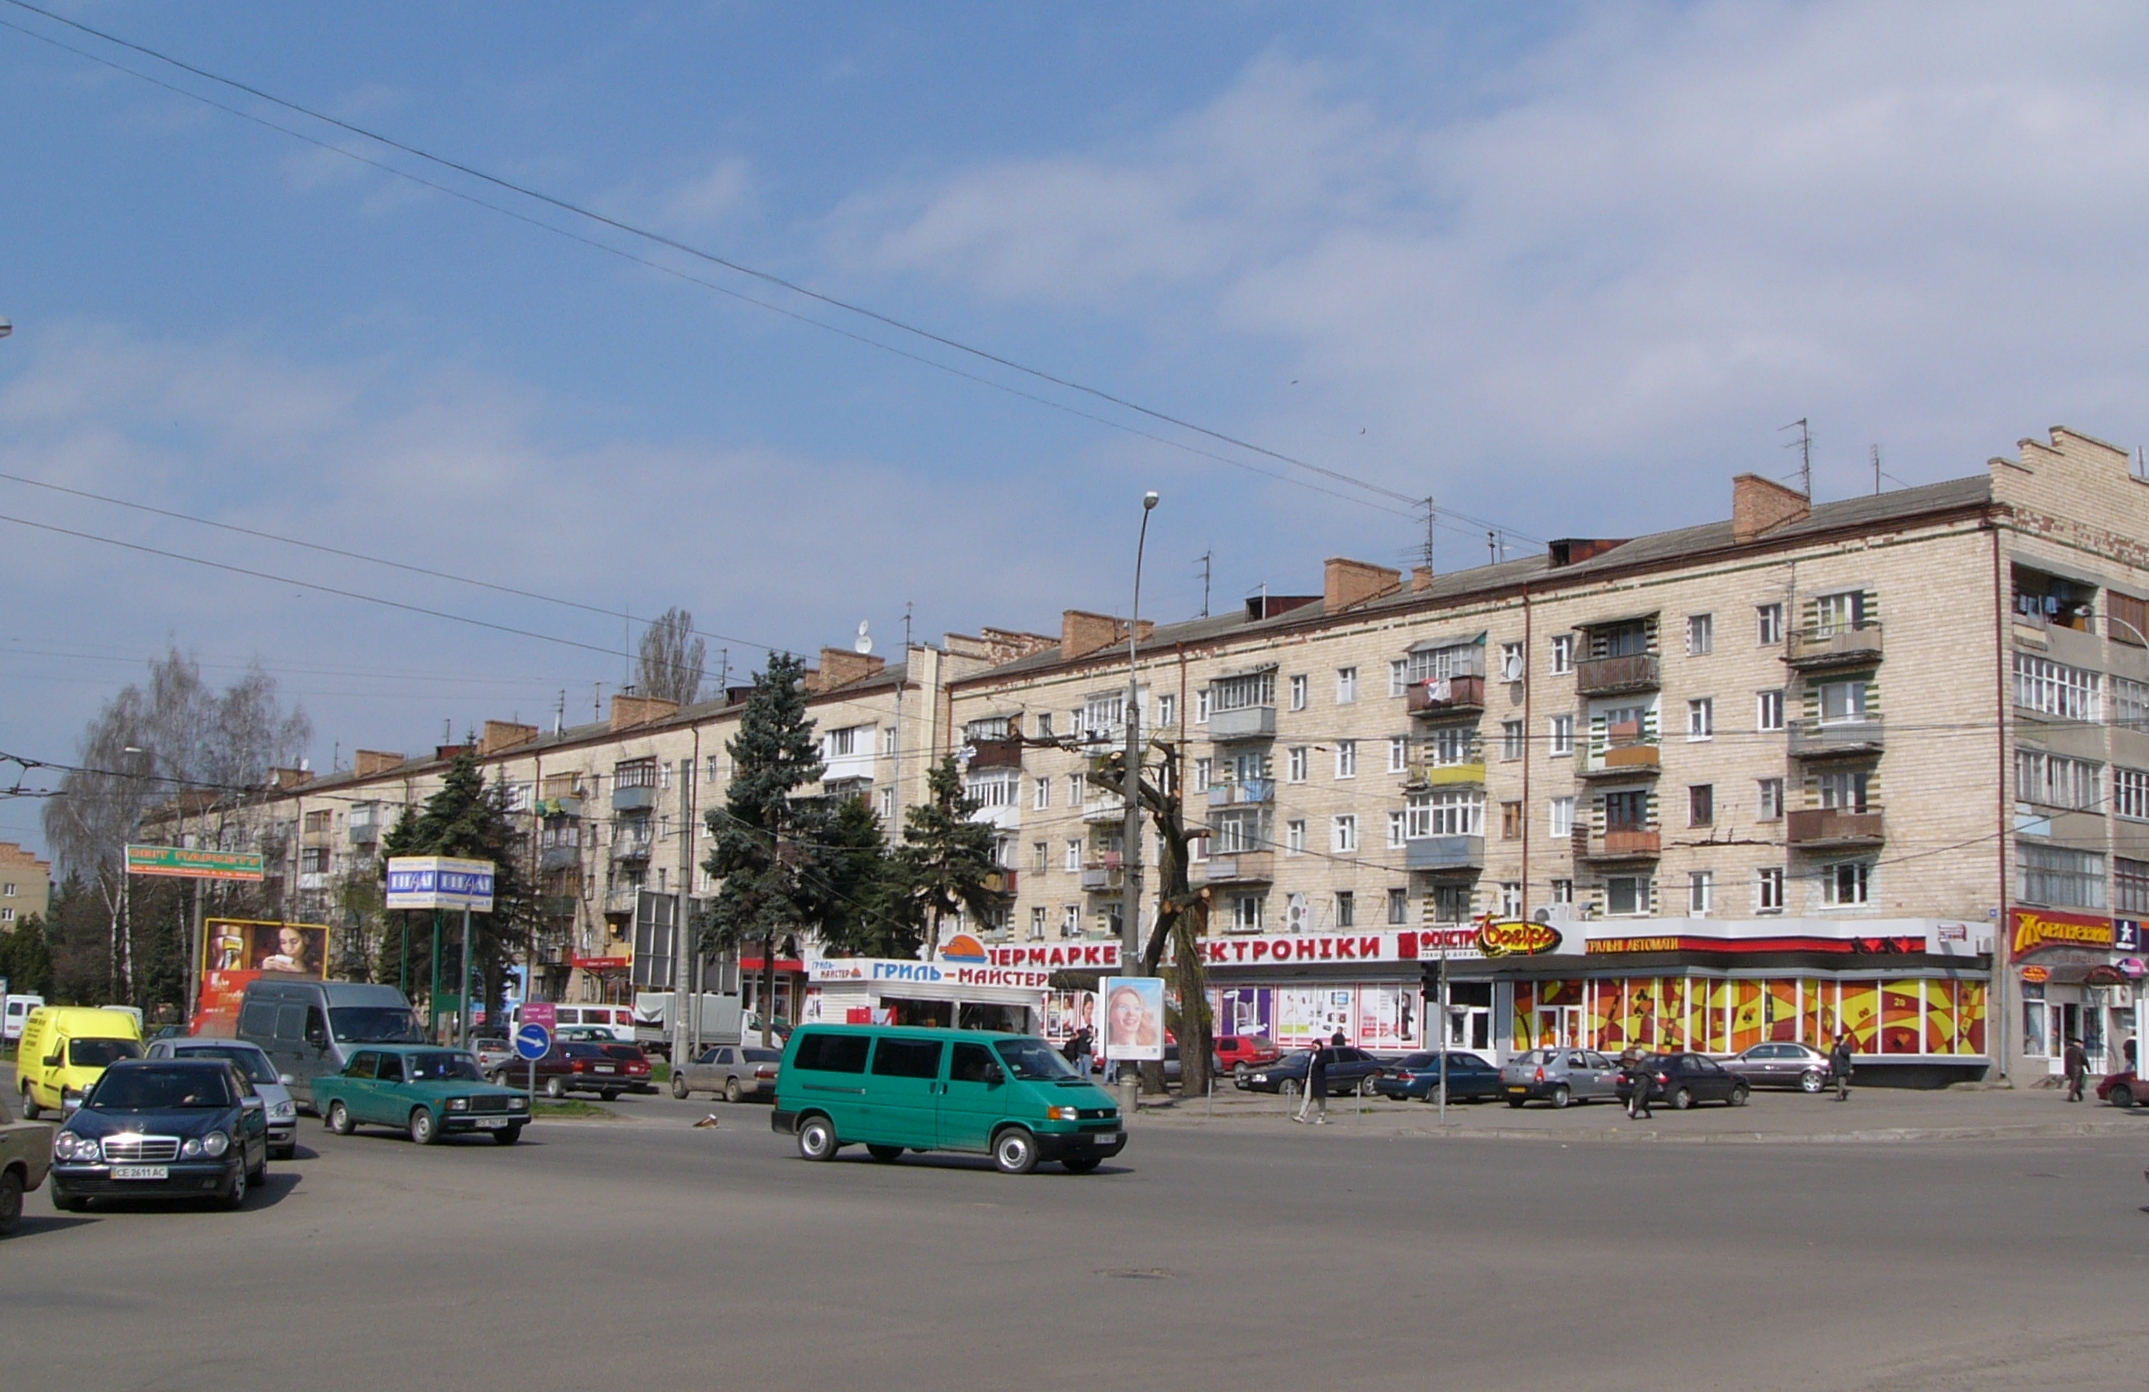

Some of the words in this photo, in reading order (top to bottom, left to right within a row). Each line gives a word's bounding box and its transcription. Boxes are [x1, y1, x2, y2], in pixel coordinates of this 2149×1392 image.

[1420, 930, 1479, 947] ФОКСТР
[1627, 937, 1678, 951] АВТОМАТИ
[988, 945, 1122, 966] ЕРМАРКЕ
[1159, 936, 1380, 962] ЕКТРОНІКИ
